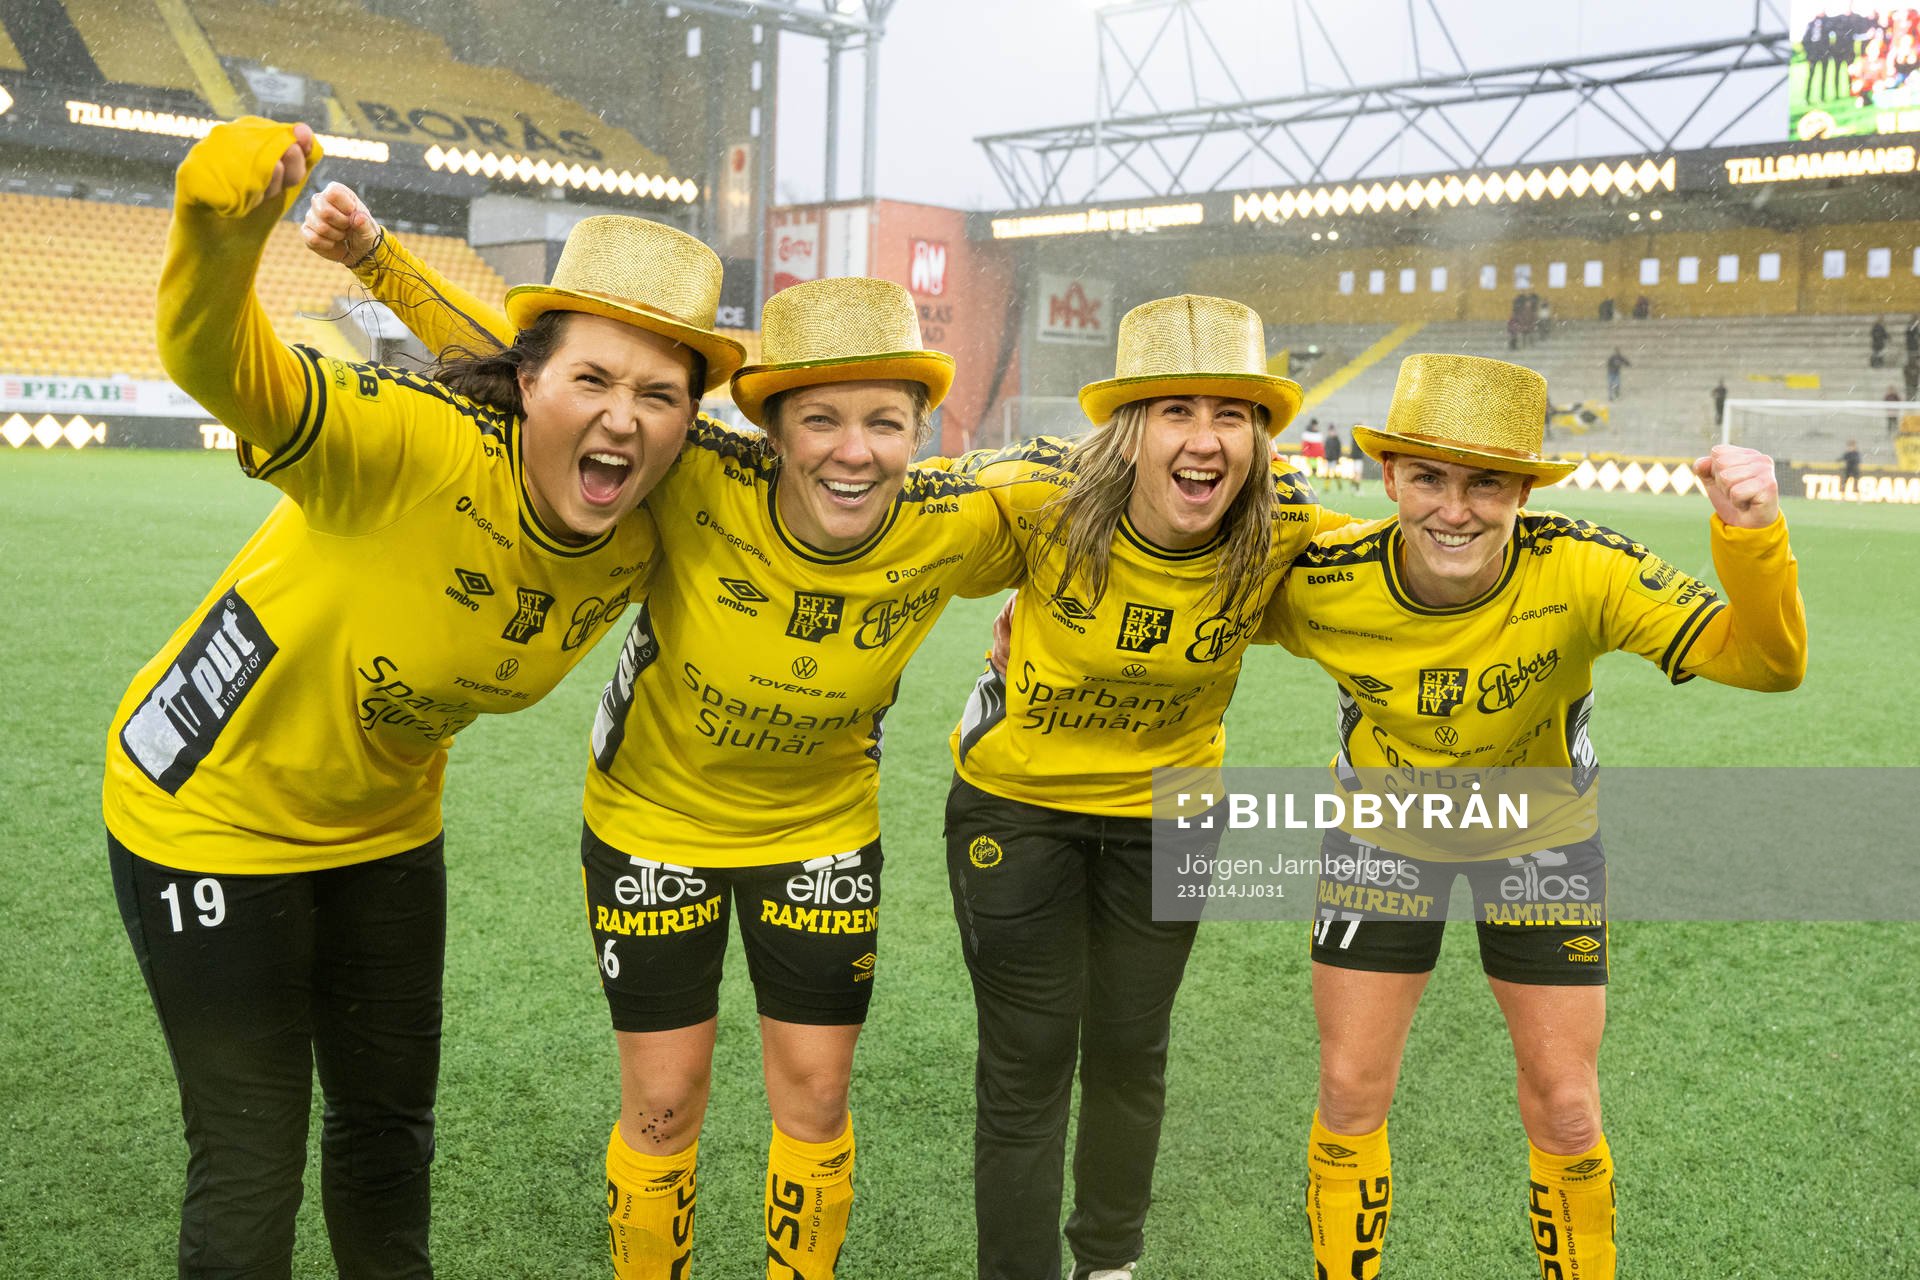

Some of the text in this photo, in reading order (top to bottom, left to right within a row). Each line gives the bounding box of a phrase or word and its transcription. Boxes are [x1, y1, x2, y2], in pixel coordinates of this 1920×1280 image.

[357, 101, 602, 160] BORÅS
[1725, 146, 1915, 184] TILLSAMMANS
[21, 381, 122, 400] PEAB
[1802, 474, 1920, 504] TILLSAM
[709, 519, 772, 568] RO-GRUPPEN
[901, 552, 964, 579] RO-GRUPPEN
[1307, 570, 1354, 585] BORÅS
[445, 585, 480, 612] umbro
[717, 594, 758, 617] umbro
[797, 595, 836, 612] EFF
[794, 611, 838, 629] EKT
[853, 587, 940, 650] Elfsborg
[1051, 611, 1086, 635] umbro
[1128, 606, 1165, 624] EFF
[790, 623, 814, 637] IV
[1124, 621, 1167, 640] EKT
[1321, 624, 1393, 642] RO-GRUPPEN
[1120, 636, 1144, 649] IV
[222, 652, 262, 706] interiör
[453, 676, 530, 701] TOVEKS BIL
[749, 674, 848, 700] TOVEKS BIL
[1423, 671, 1460, 686] EFF
[1476, 648, 1561, 714] Elfsborg
[1356, 689, 1388, 707] umbro
[1421, 684, 1463, 701] EKT
[1421, 698, 1443, 713] IV
[1022, 706, 1189, 735] Sjuhärad
[1474, 744, 1497, 753] BIL
[614, 867, 707, 907] ellos
[786, 867, 873, 905] ellos
[1500, 862, 1590, 901] ellos
[160, 877, 226, 933] 19
[1318, 880, 1434, 917] RAMIRENT
[595, 895, 722, 937] RAMIRENT
[1568, 953, 1599, 962] umbro
[622, 1193, 633, 1220] BOW
[1313, 1183, 1322, 1209] BOWE
[1558, 1189, 1571, 1223] GROUP
[812, 1215, 821, 1227] OF
[807, 1230, 818, 1253] PART
[1318, 1227, 1326, 1247] PART
[1564, 1225, 1576, 1256] BOWE
[621, 1240, 630, 1263] PART
[1569, 1257, 1579, 1270] OF
